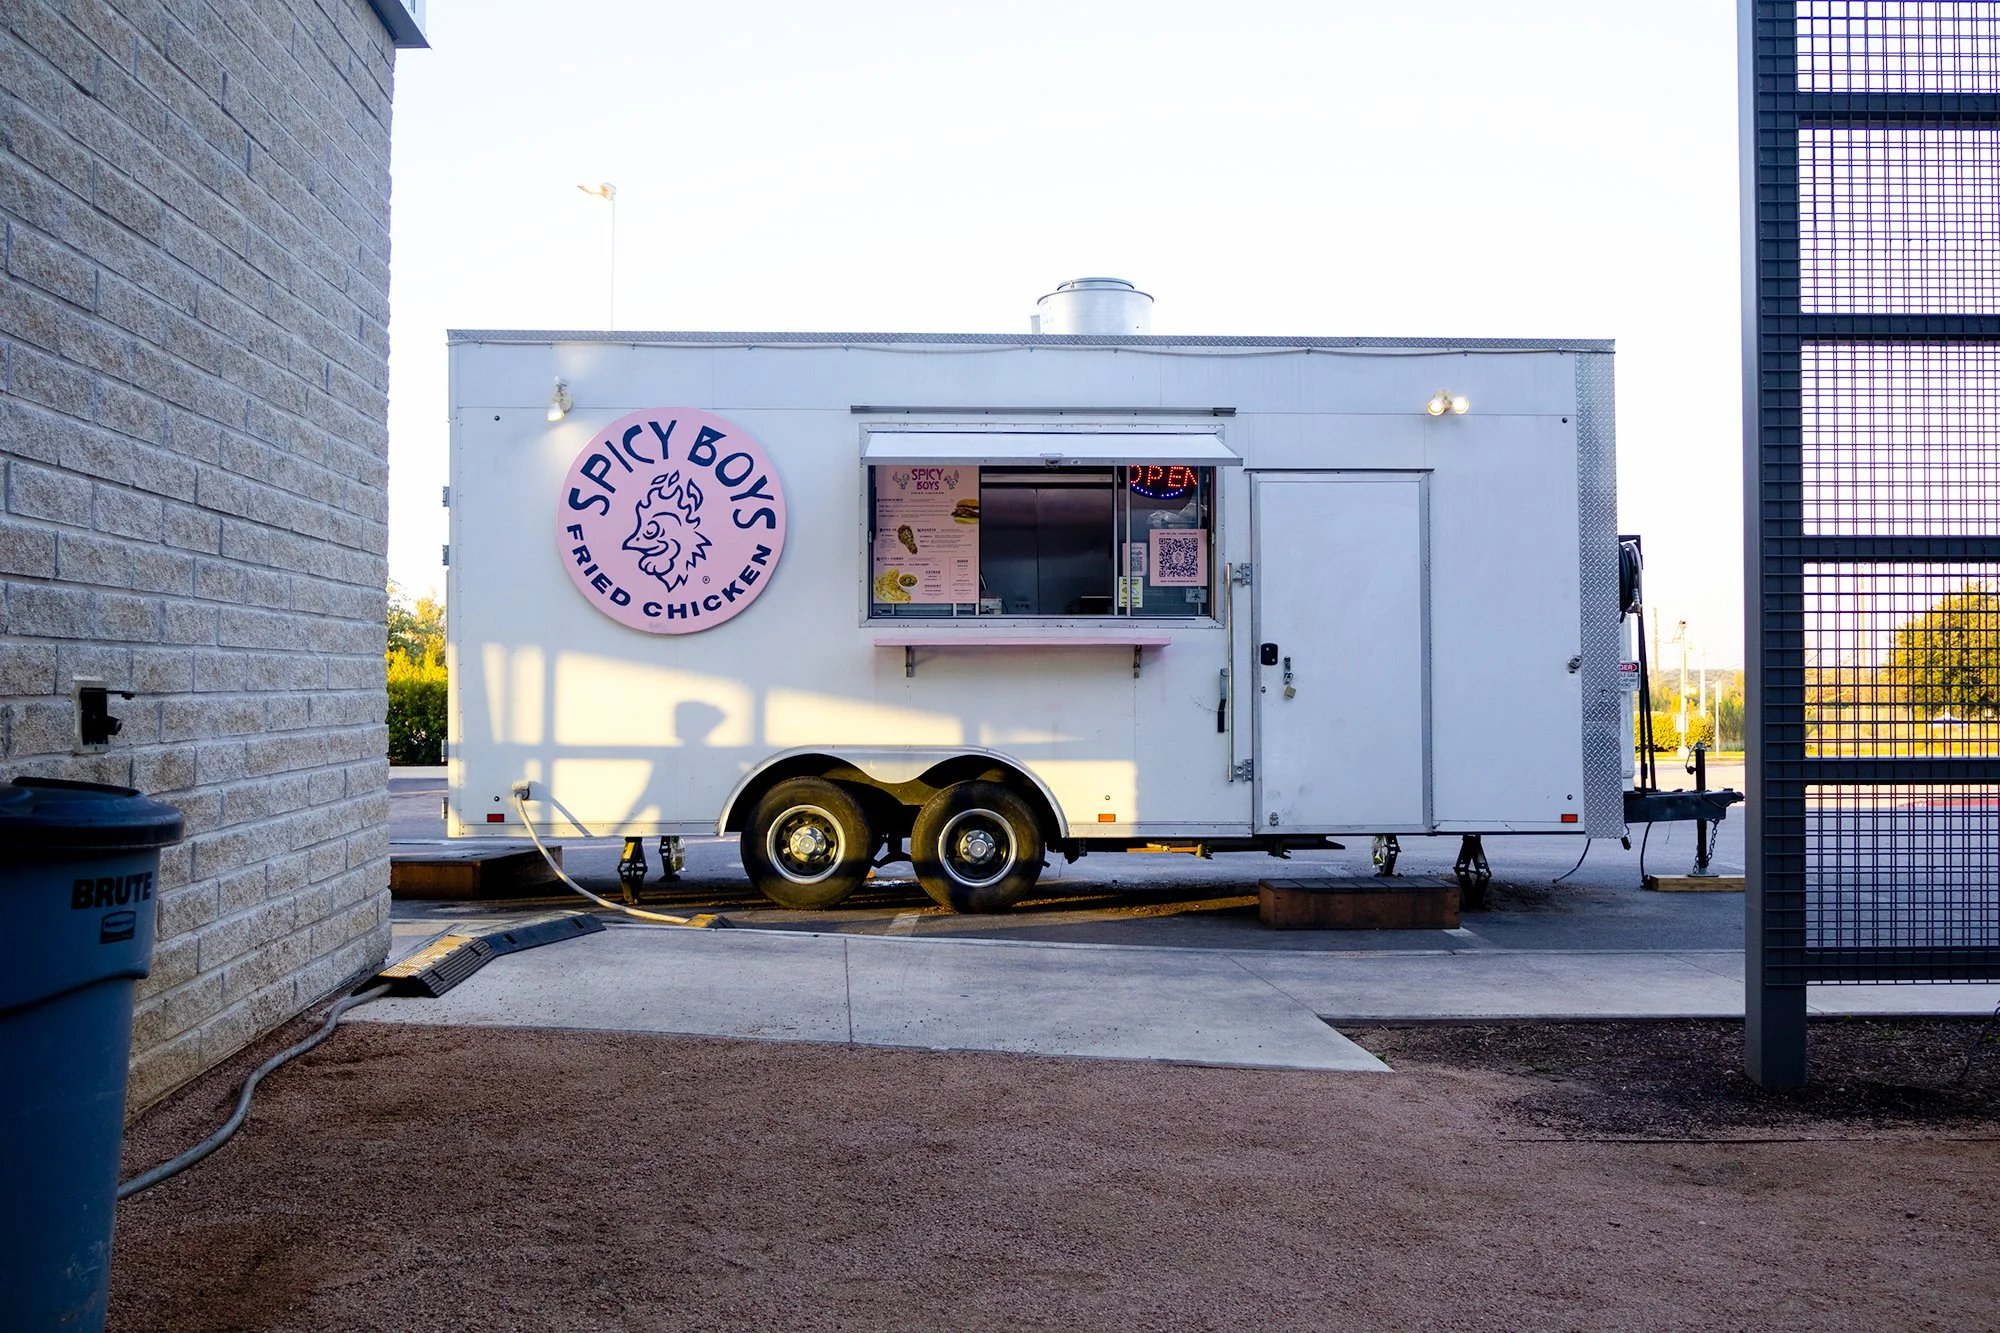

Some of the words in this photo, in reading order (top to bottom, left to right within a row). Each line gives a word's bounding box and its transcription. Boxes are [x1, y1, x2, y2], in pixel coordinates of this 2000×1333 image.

[568, 420, 677, 516] SPICY
[687, 425, 776, 530] BOYS
[911, 468, 944, 481] SPICY
[916, 481, 940, 490] BOYS
[1130, 464, 1198, 487] OPEN
[566, 523, 632, 607] FRIED
[643, 544, 772, 619] CHICKEN
[71, 871, 153, 909] BRUTE
